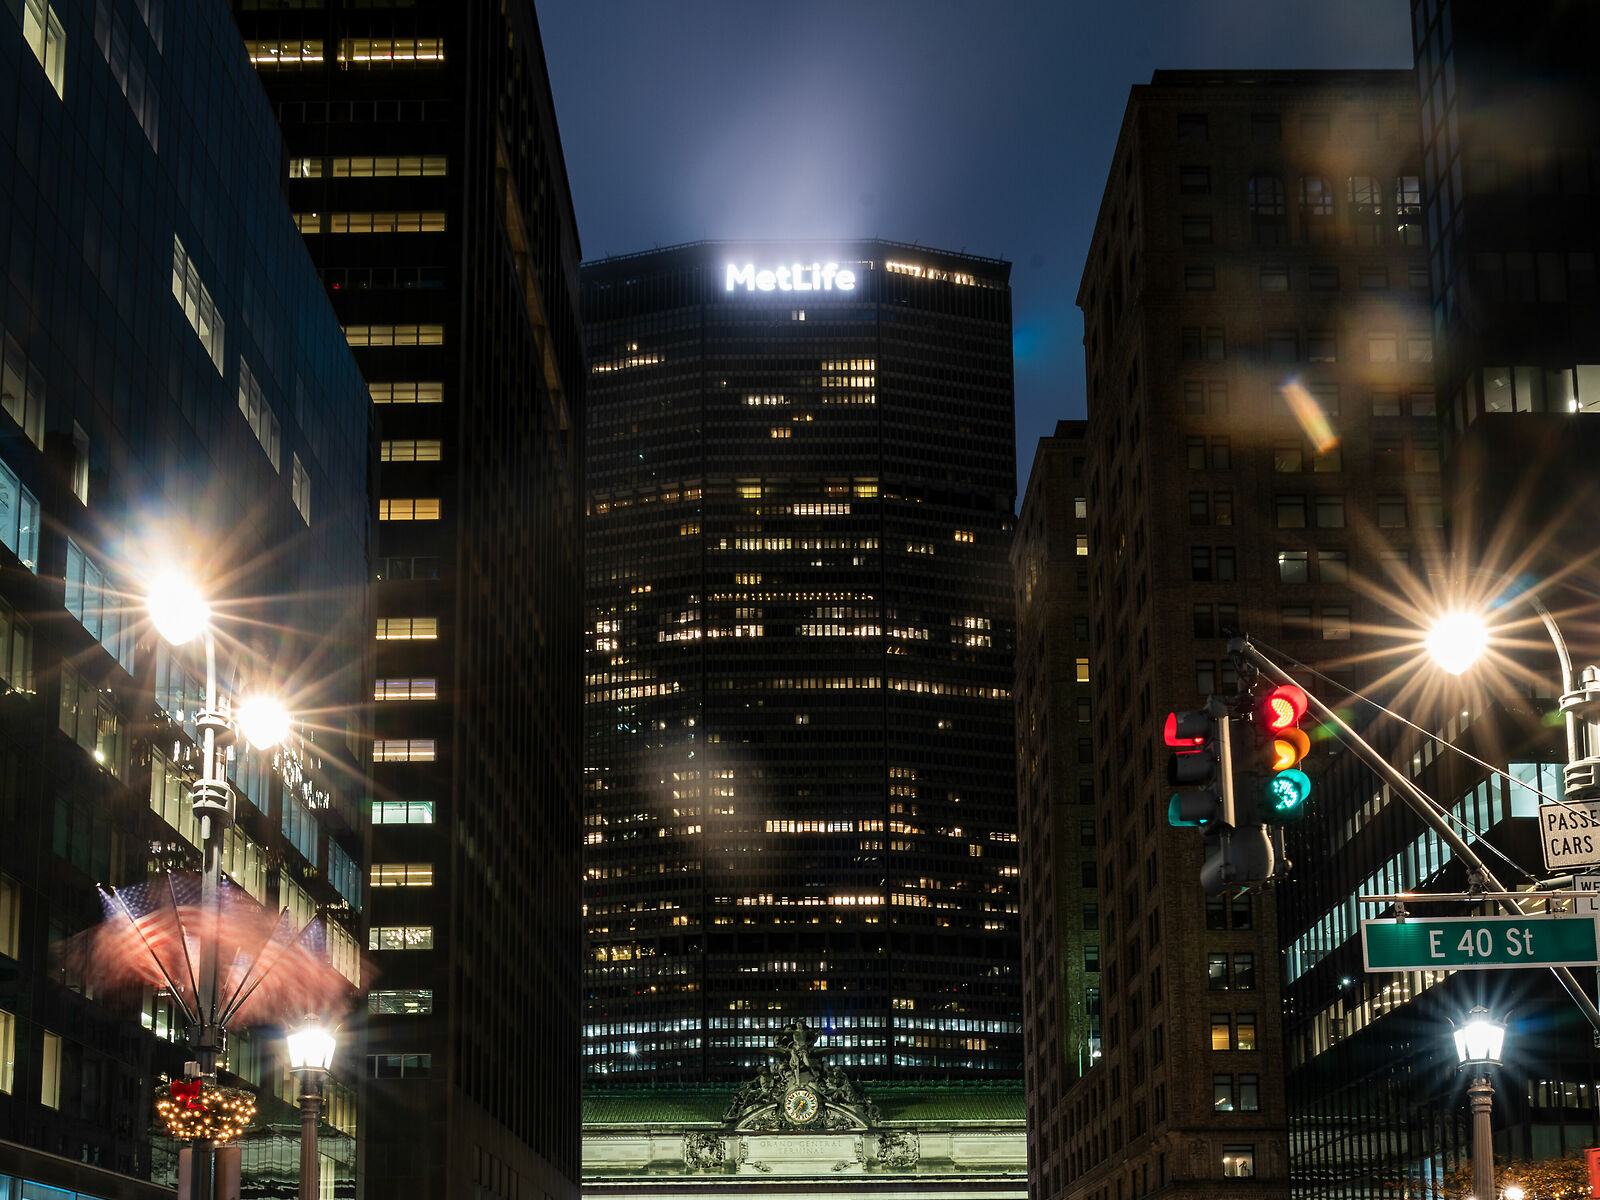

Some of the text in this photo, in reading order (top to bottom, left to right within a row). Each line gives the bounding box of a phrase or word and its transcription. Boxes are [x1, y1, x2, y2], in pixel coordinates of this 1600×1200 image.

[726, 264, 856, 291] MetLife
[1551, 835, 1594, 857] CARS
[1429, 927, 1535, 958] E 40 St
